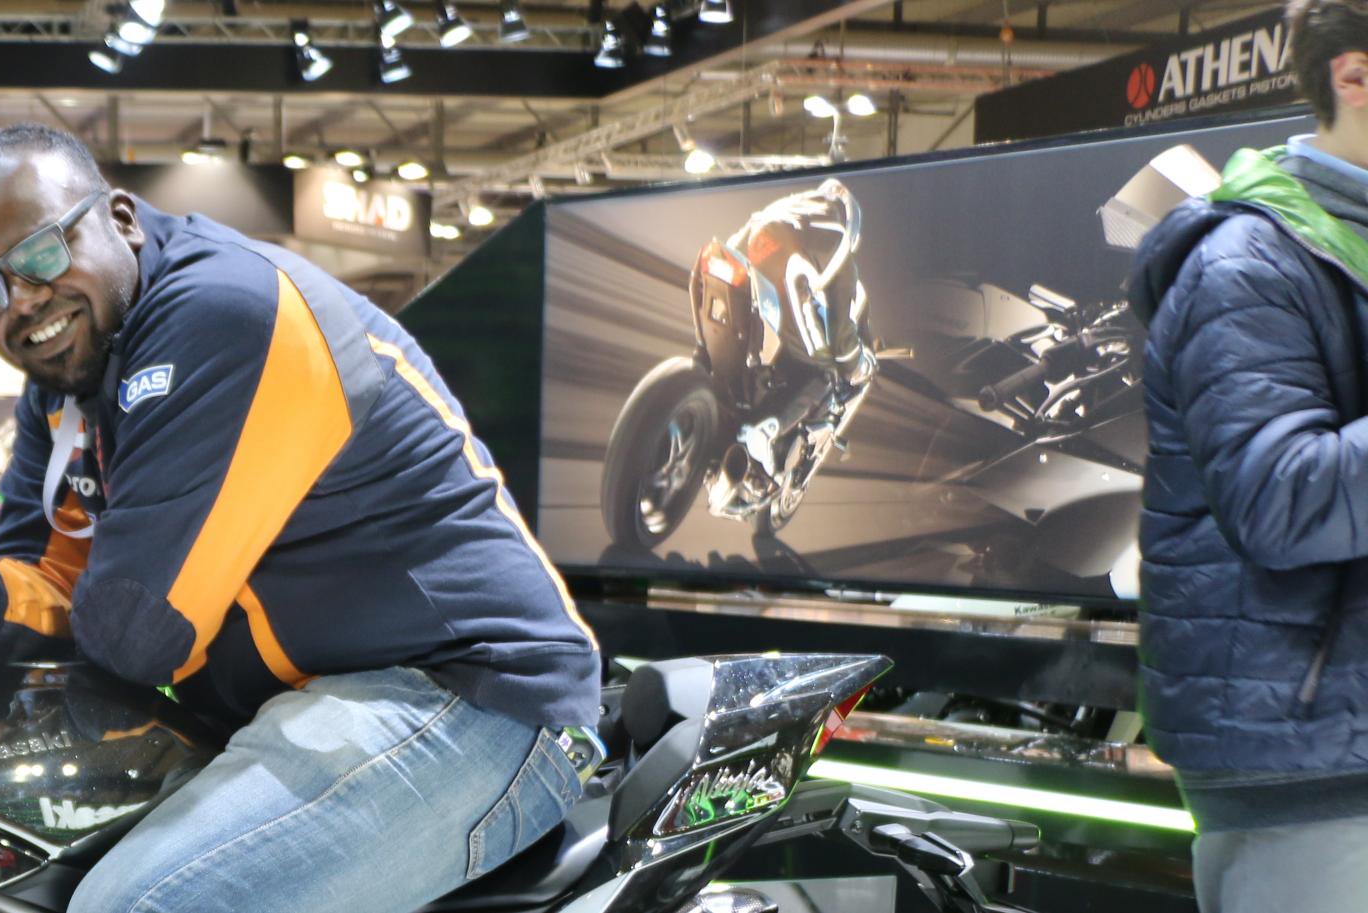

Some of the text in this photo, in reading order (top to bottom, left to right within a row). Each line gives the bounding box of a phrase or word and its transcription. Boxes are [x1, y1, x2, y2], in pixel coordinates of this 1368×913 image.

[1124, 102, 1187, 127] CYLINDERS
[1188, 88, 1247, 112] GASKETS
[126, 371, 167, 403] GAS
